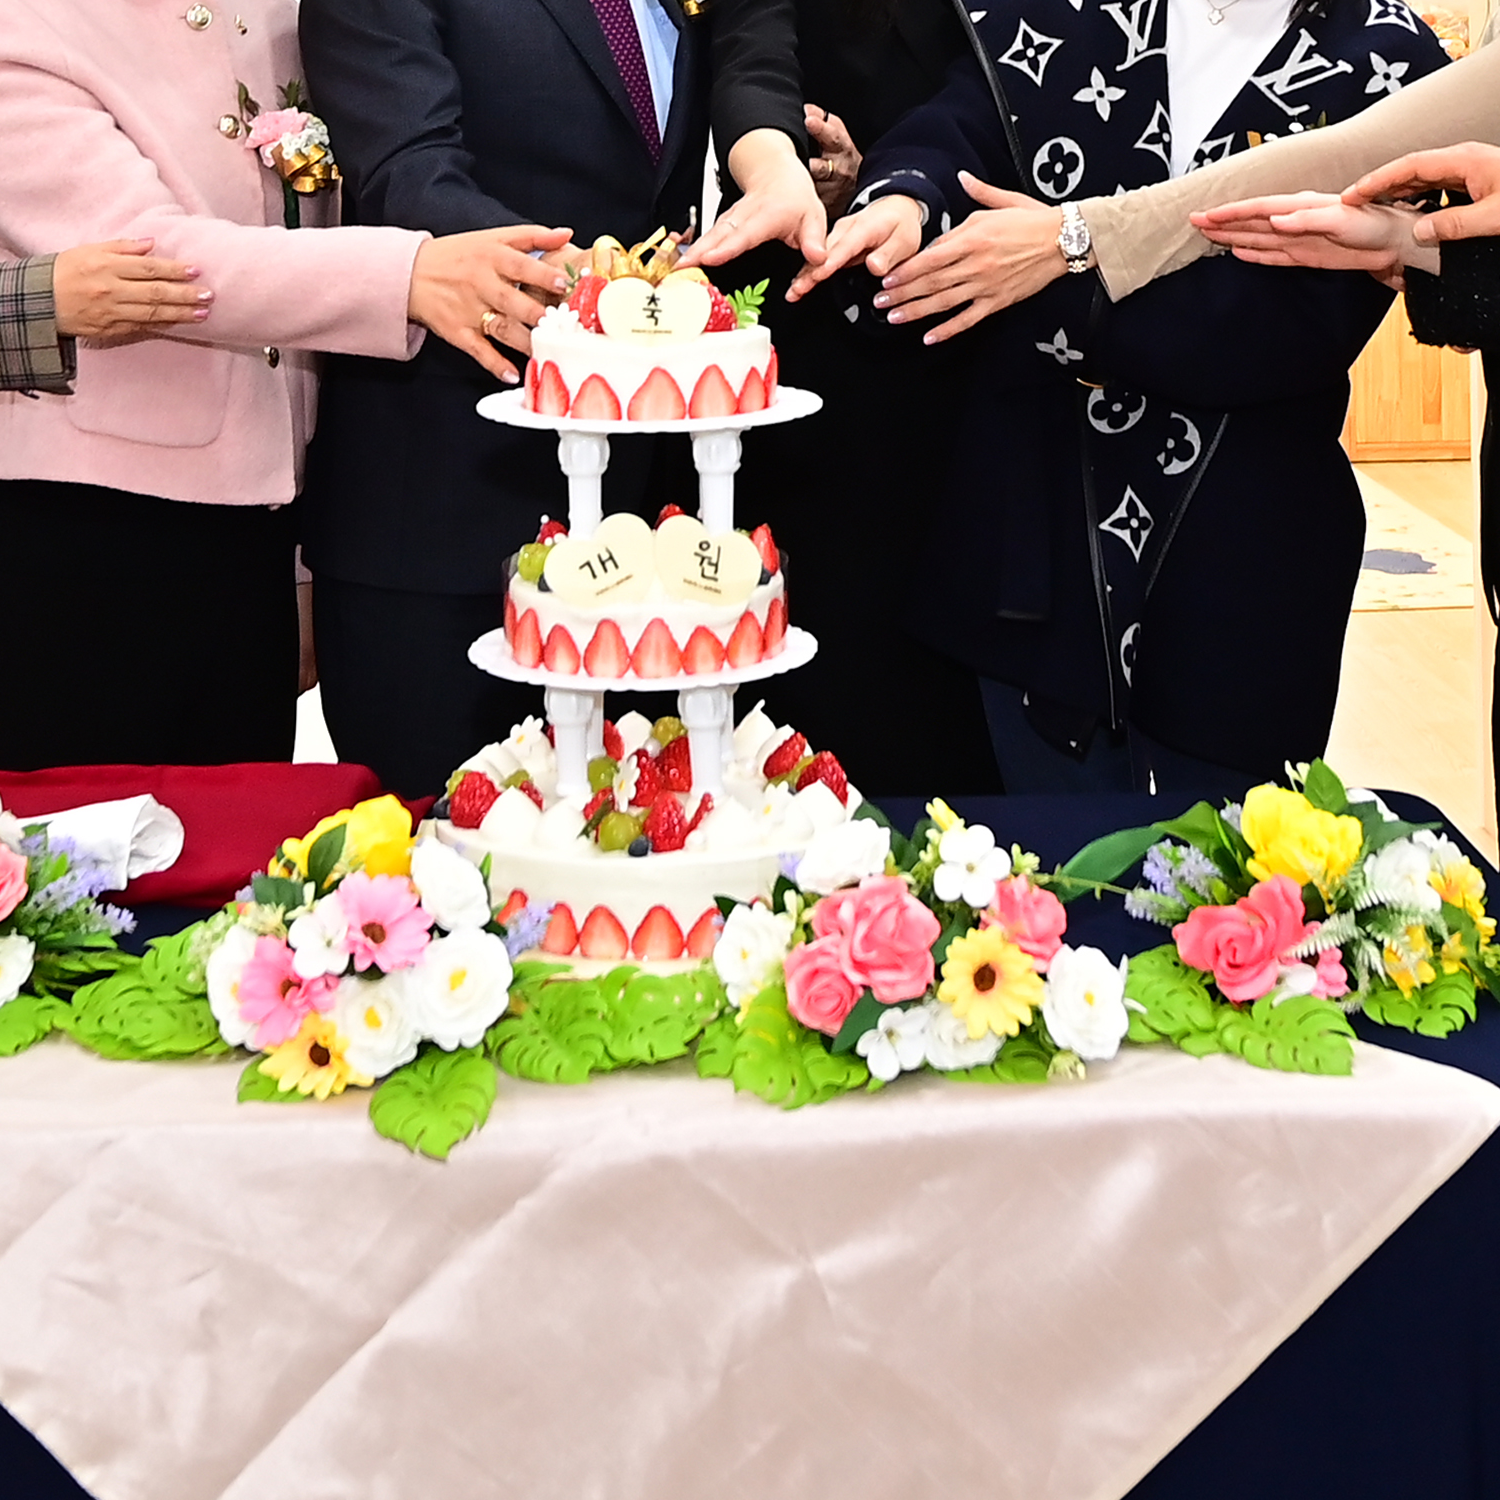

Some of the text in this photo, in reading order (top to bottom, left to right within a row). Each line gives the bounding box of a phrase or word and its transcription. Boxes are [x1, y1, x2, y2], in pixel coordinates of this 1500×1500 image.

[642, 293, 663, 327] 축
[578, 547, 620, 581] 개
[693, 540, 722, 583] 원
